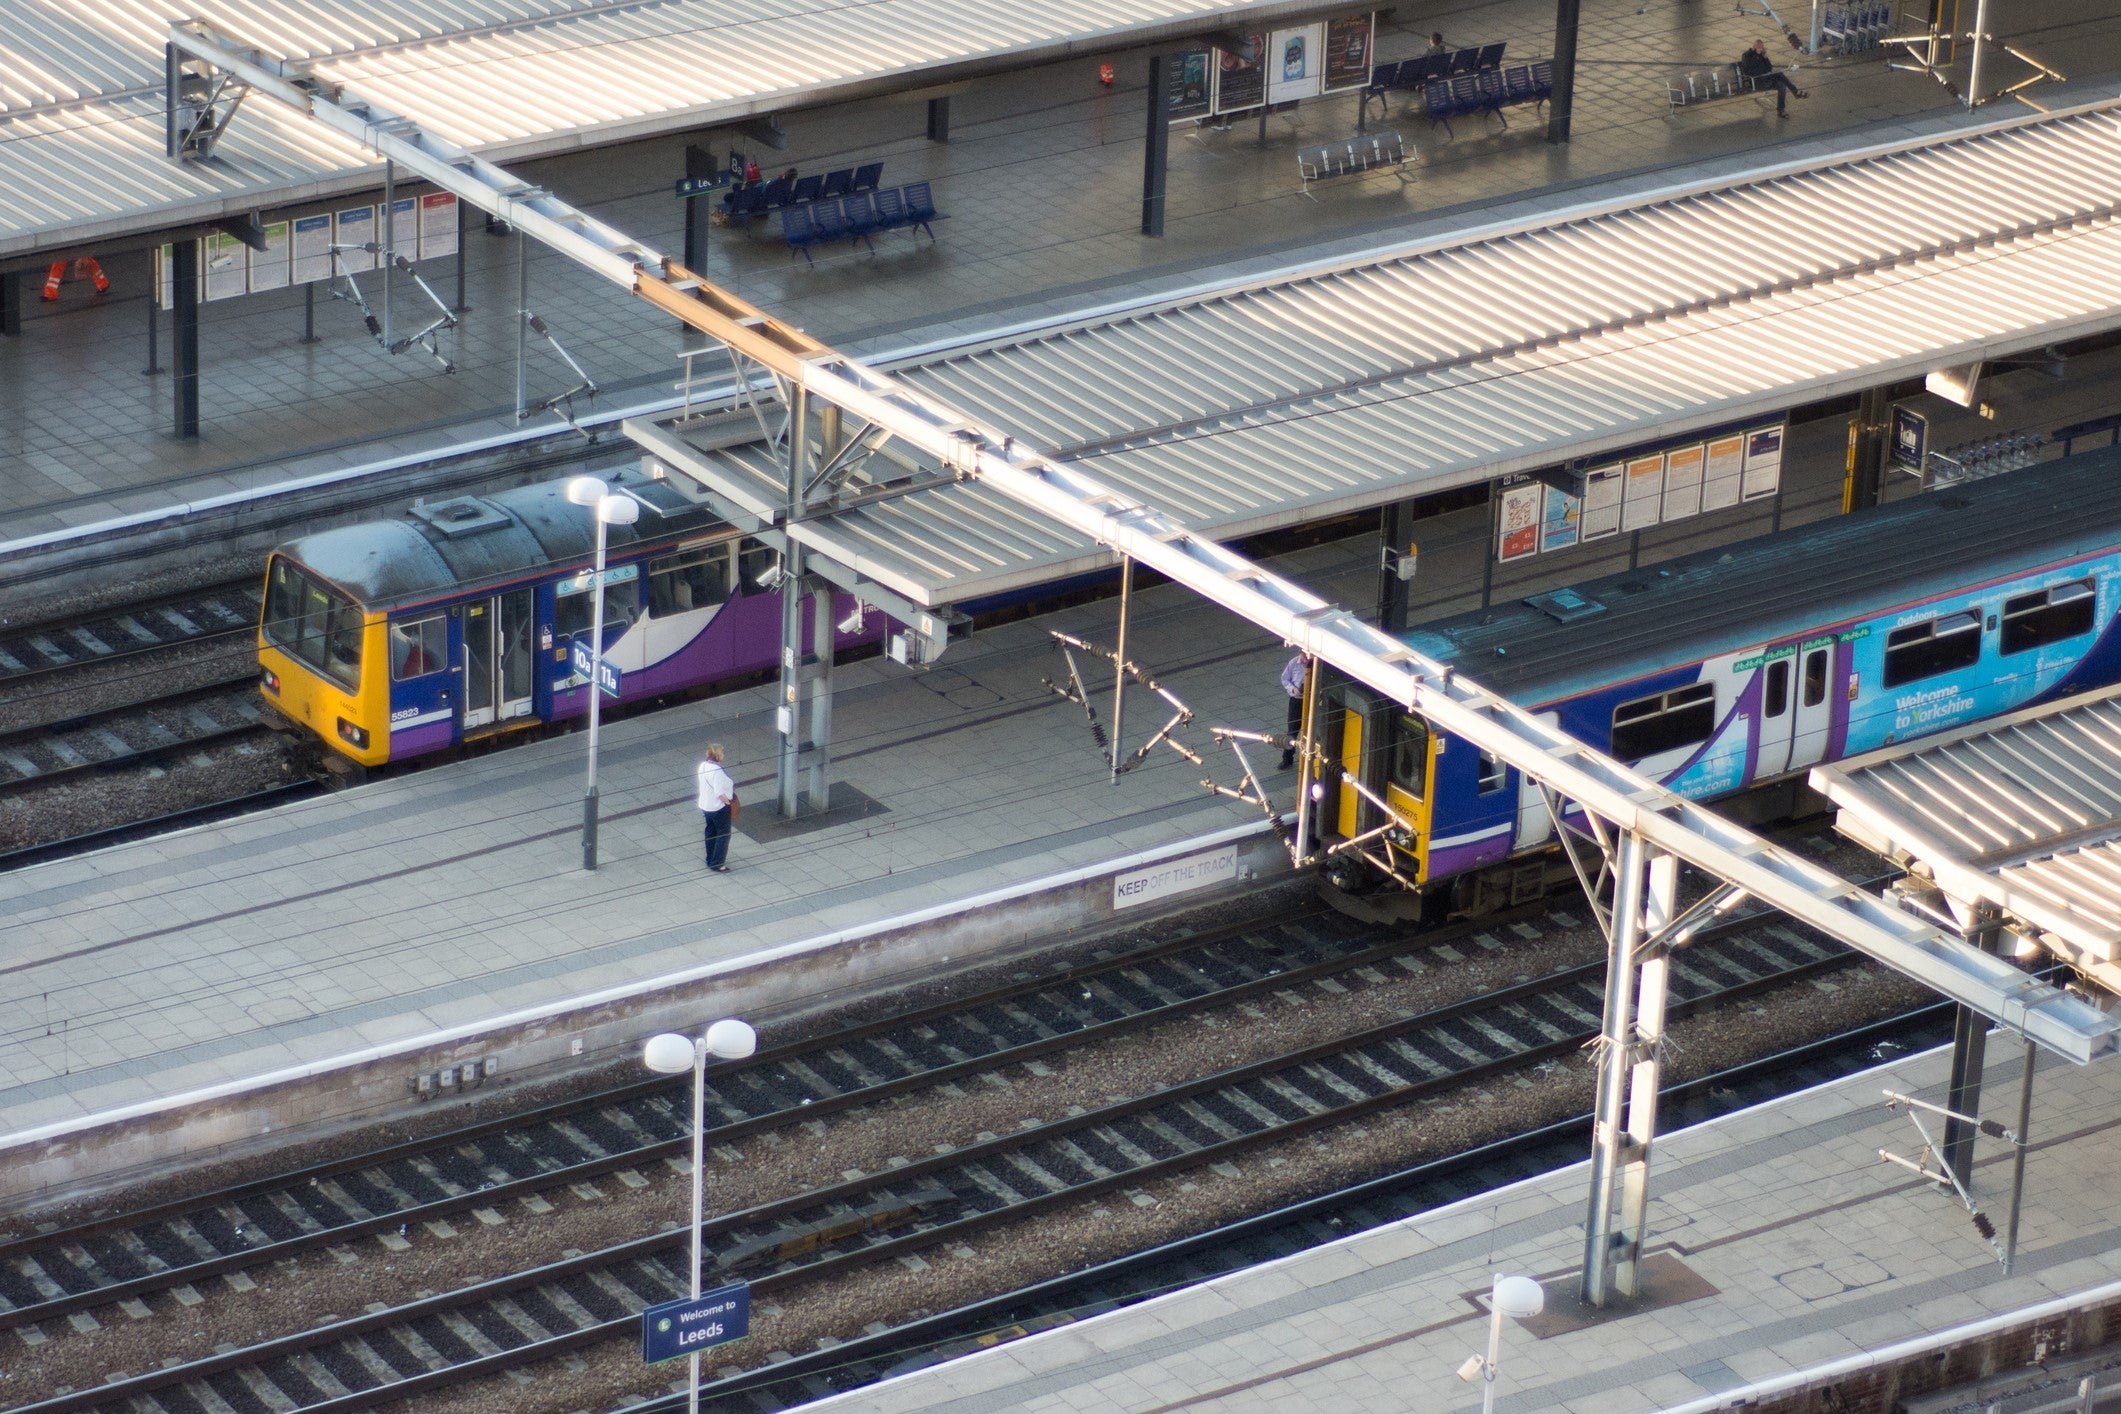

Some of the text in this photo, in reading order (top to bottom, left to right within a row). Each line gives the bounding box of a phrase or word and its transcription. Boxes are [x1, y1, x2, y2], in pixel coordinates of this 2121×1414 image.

[731, 158, 743, 175] 8a
[574, 648, 591, 673] 10a
[601, 666, 616, 690] 11a
[1896, 685, 1959, 712] Welcome
[391, 707, 419, 721] 55823
[1895, 697, 1975, 730] to Yorkshire
[1680, 778, 1731, 798] hire.com
[1118, 854, 1234, 897] KEEP OFF THE TRACK
[680, 1301, 736, 1322] Welcome to
[679, 1322, 724, 1346] Leeds
